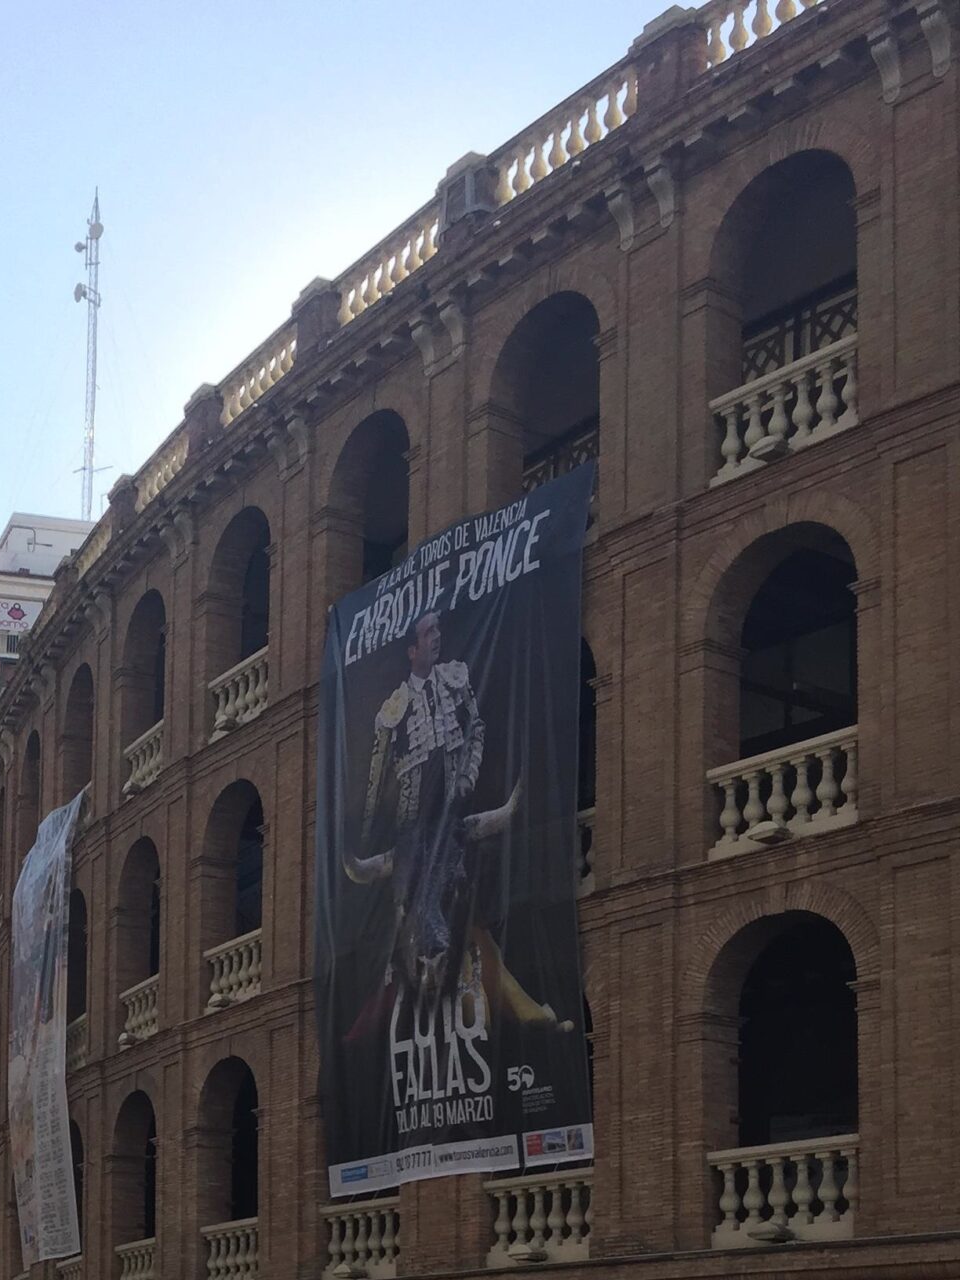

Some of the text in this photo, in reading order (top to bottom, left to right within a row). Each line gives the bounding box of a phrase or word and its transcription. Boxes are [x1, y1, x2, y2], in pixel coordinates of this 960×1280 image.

[420, 531, 451, 569] TOROS
[455, 523, 470, 550] DE
[474, 498, 527, 542] VALENCIA
[450, 509, 550, 611] PONCE
[433, 1102, 444, 1128] 19
[445, 1095, 494, 1125] MARZO
